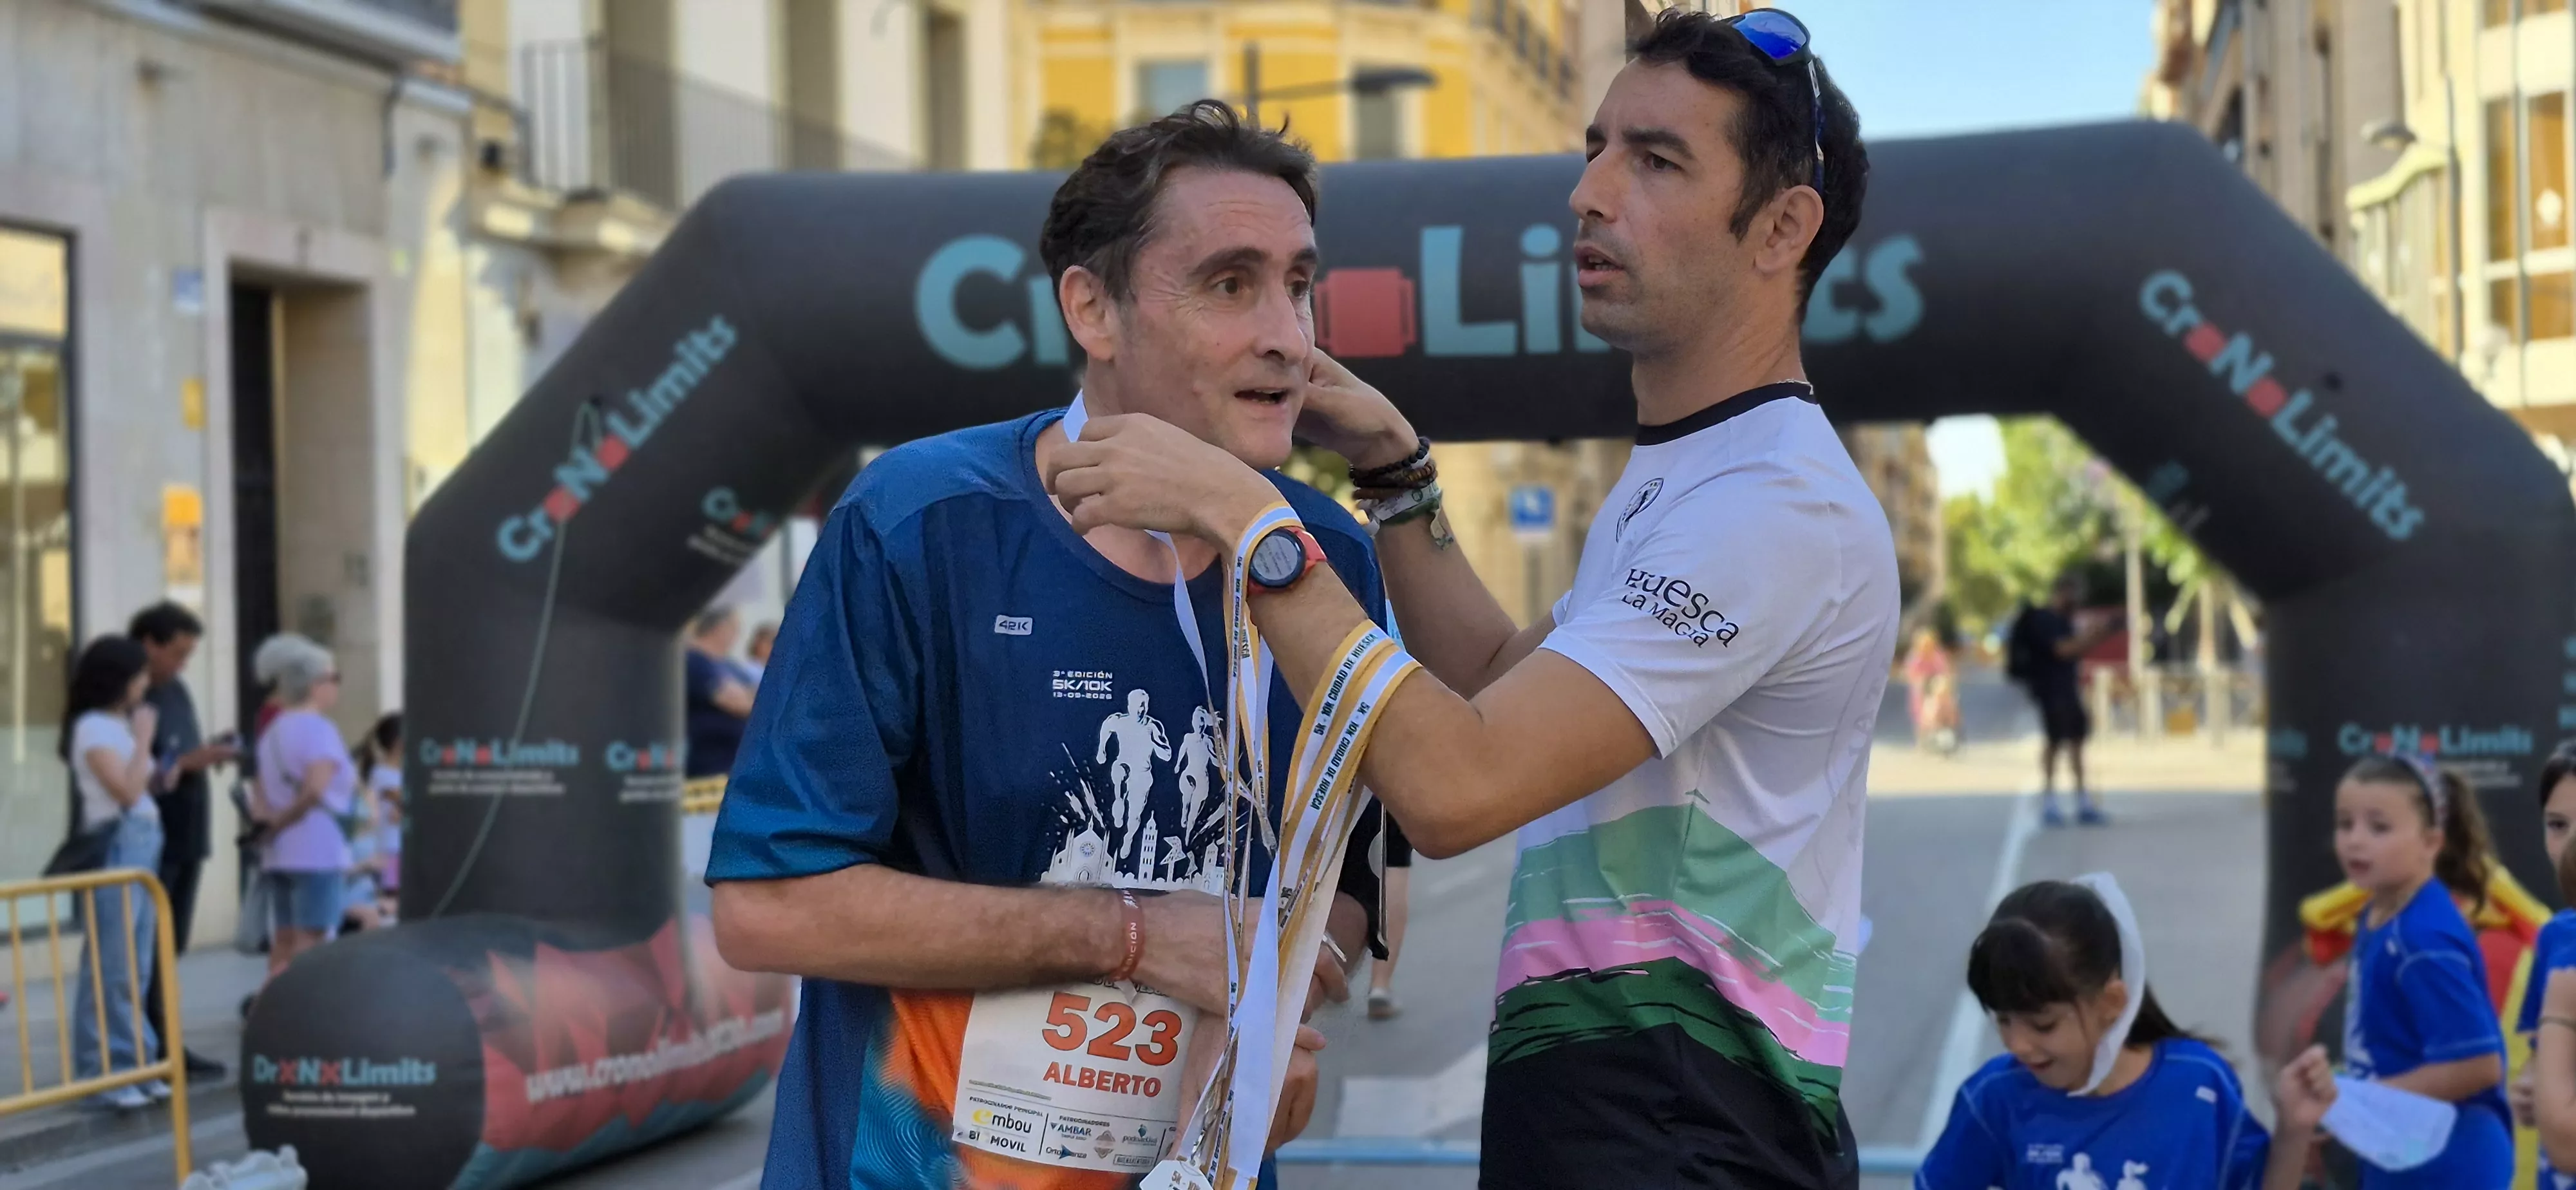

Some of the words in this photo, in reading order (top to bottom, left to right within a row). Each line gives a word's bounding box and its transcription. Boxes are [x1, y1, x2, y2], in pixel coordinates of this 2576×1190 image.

[999, 620, 1029, 631] 42K
[1066, 670, 1113, 679] EDICIÓN
[1328, 668, 1349, 701] CIUDAD
[1343, 656, 1356, 670] DE
[1351, 633, 1378, 659] HUESCA
[1052, 679, 1113, 692] 5K/10K
[1331, 738, 1350, 768] CIUDAD
[1325, 766, 1336, 780] DE
[1310, 779, 1331, 811] HUESCA
[1041, 991, 1183, 1066] 523
[1042, 1061, 1162, 1098] ALBERTO
[972, 1108, 1032, 1133] embou
[1056, 1123, 1092, 1137] AMBAR
[1059, 1115, 1110, 1128] PATROCINADORES
